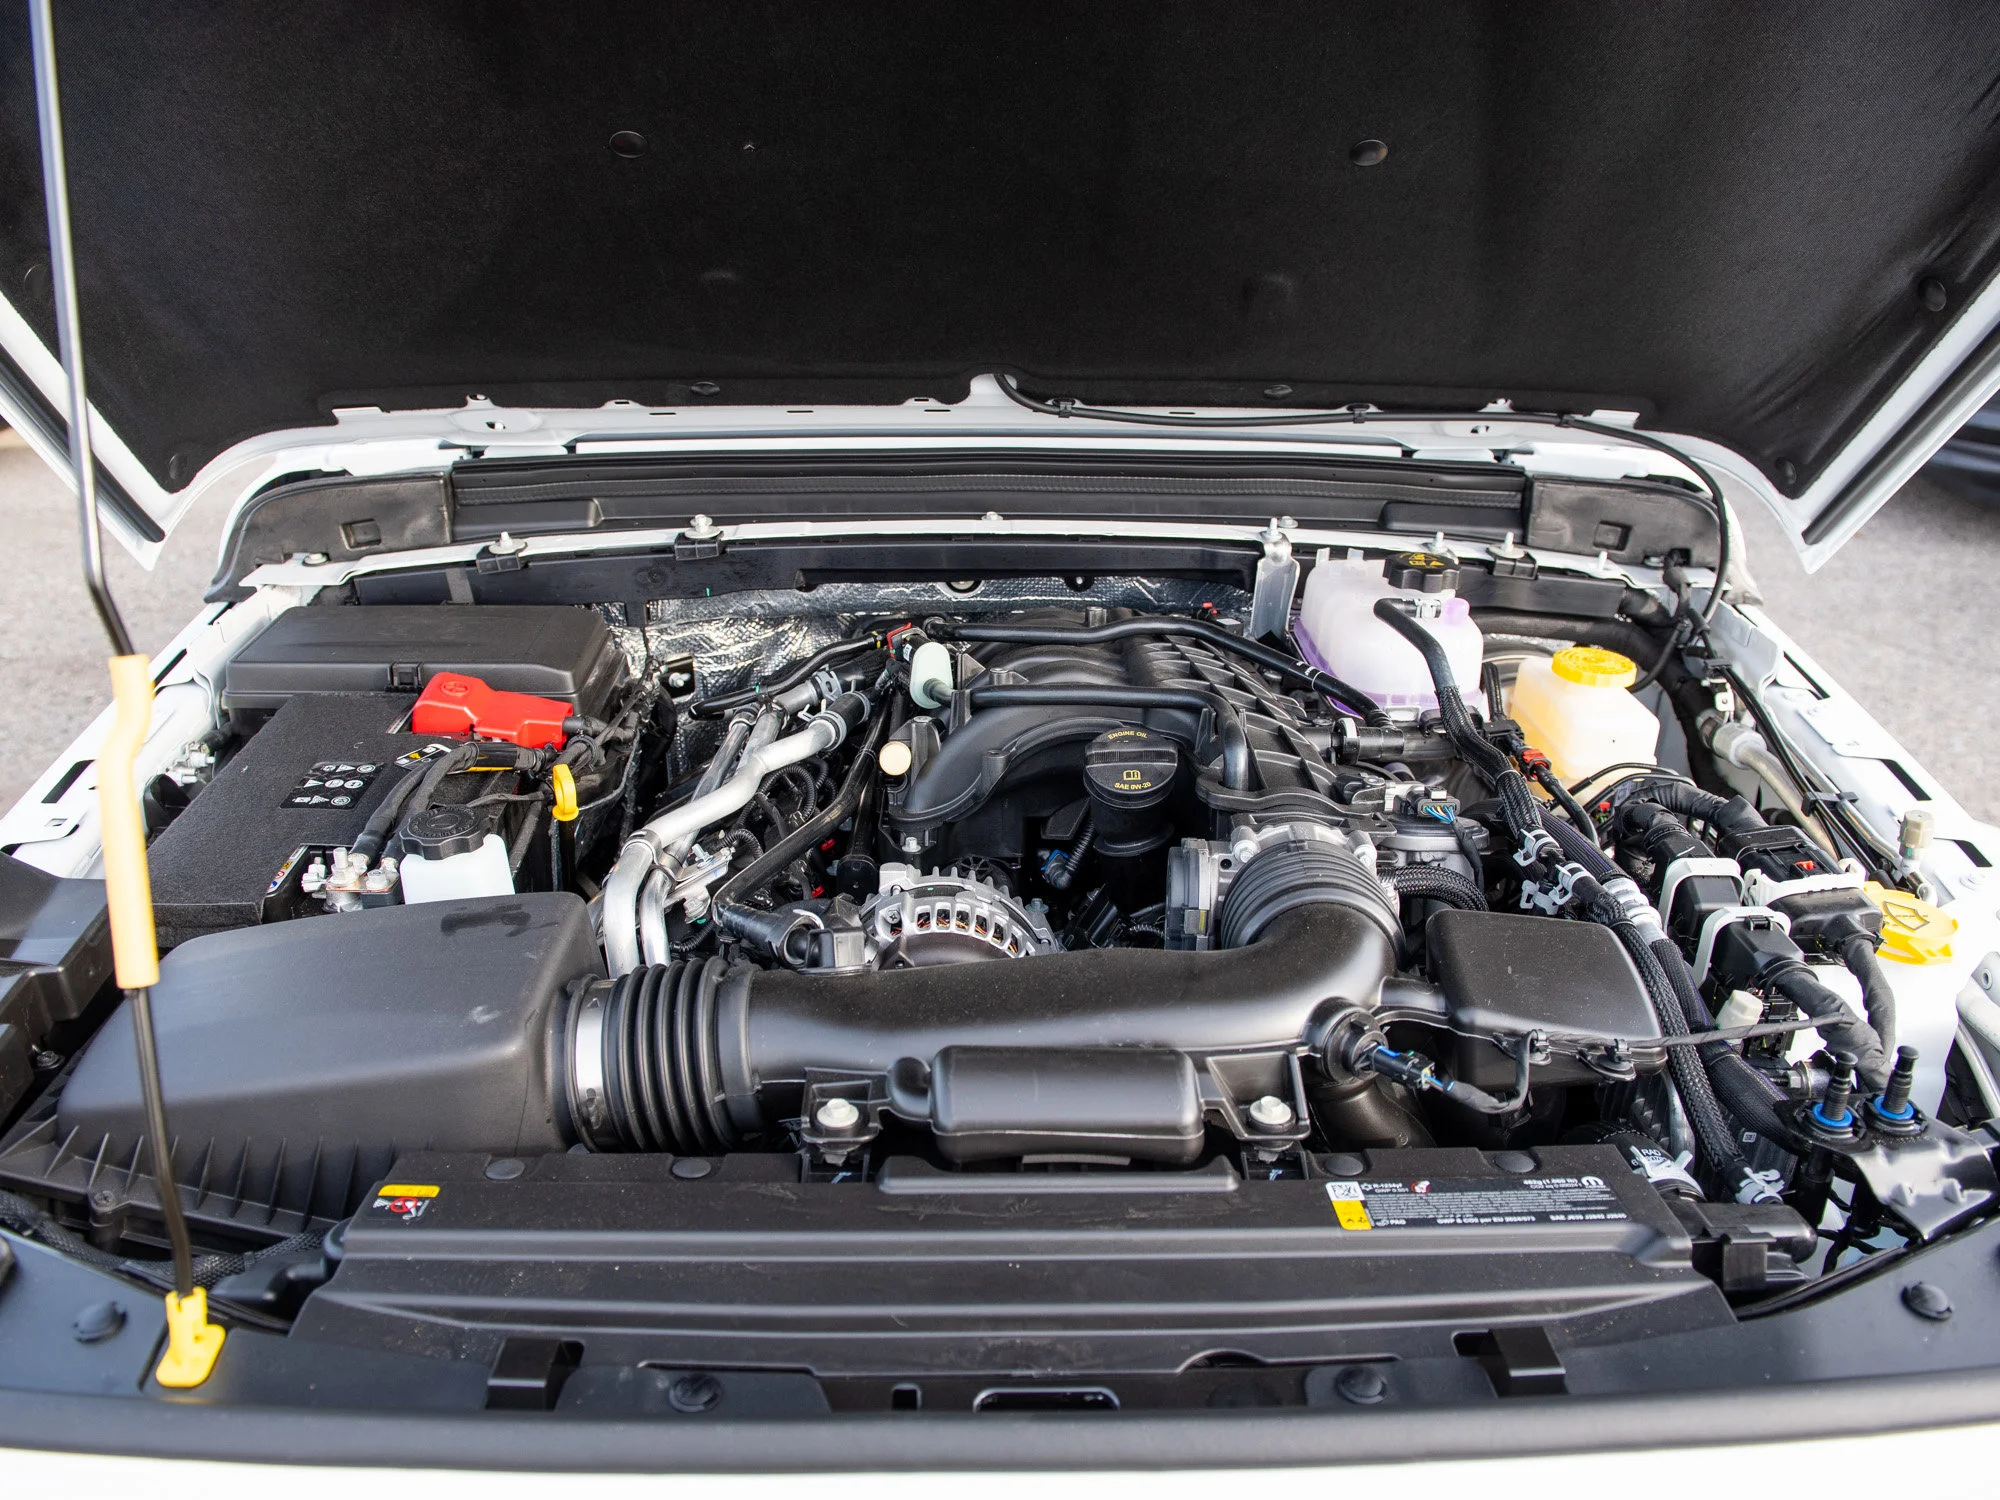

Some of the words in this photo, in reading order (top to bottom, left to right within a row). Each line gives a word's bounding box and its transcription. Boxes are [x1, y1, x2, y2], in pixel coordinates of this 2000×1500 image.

[1107, 730, 1135, 740] ENGINE
[1136, 731, 1148, 739] OIL
[1114, 782, 1130, 790] SAE
[1130, 781, 1152, 790] 0W-20
